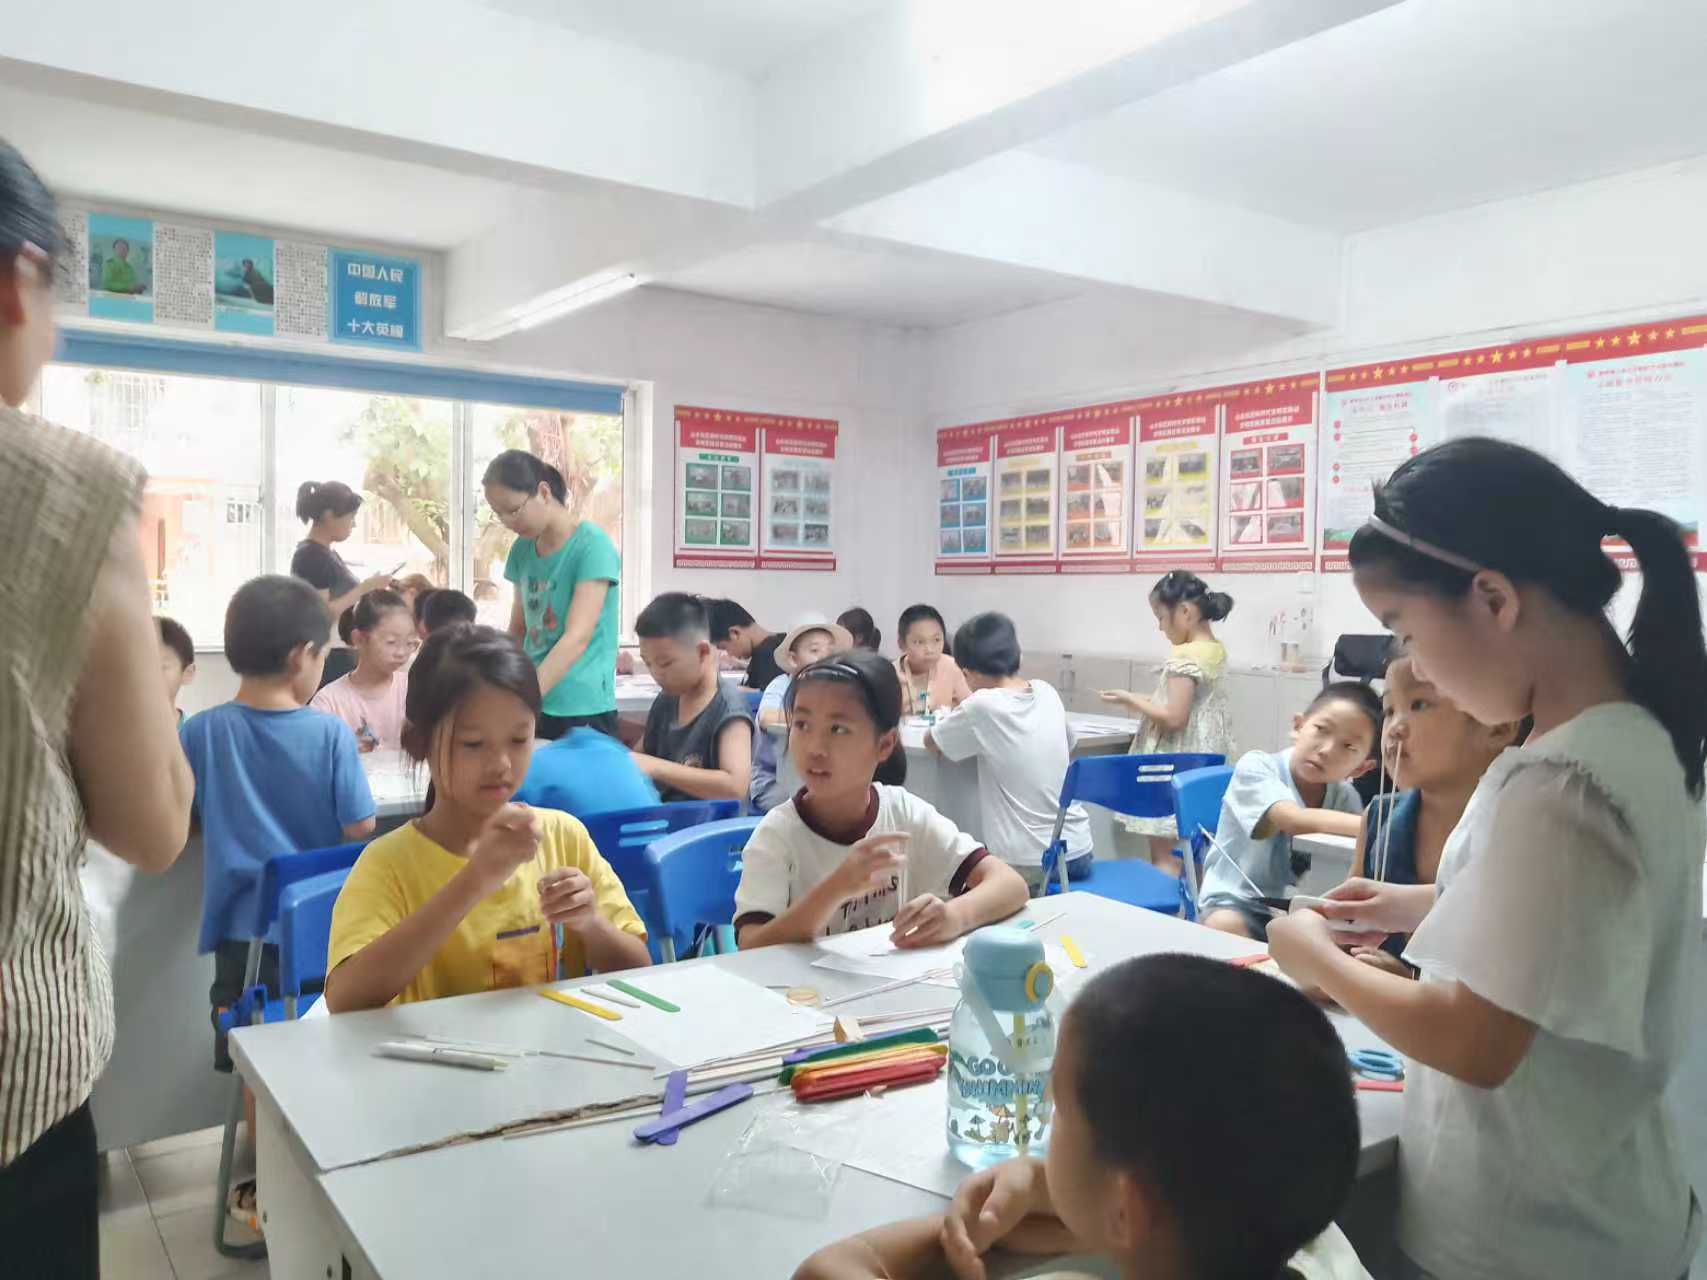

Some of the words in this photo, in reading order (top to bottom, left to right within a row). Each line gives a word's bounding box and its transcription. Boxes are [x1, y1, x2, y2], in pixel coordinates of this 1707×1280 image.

[347, 263, 404, 283] 中国人民
[354, 291, 397, 309] 解放军
